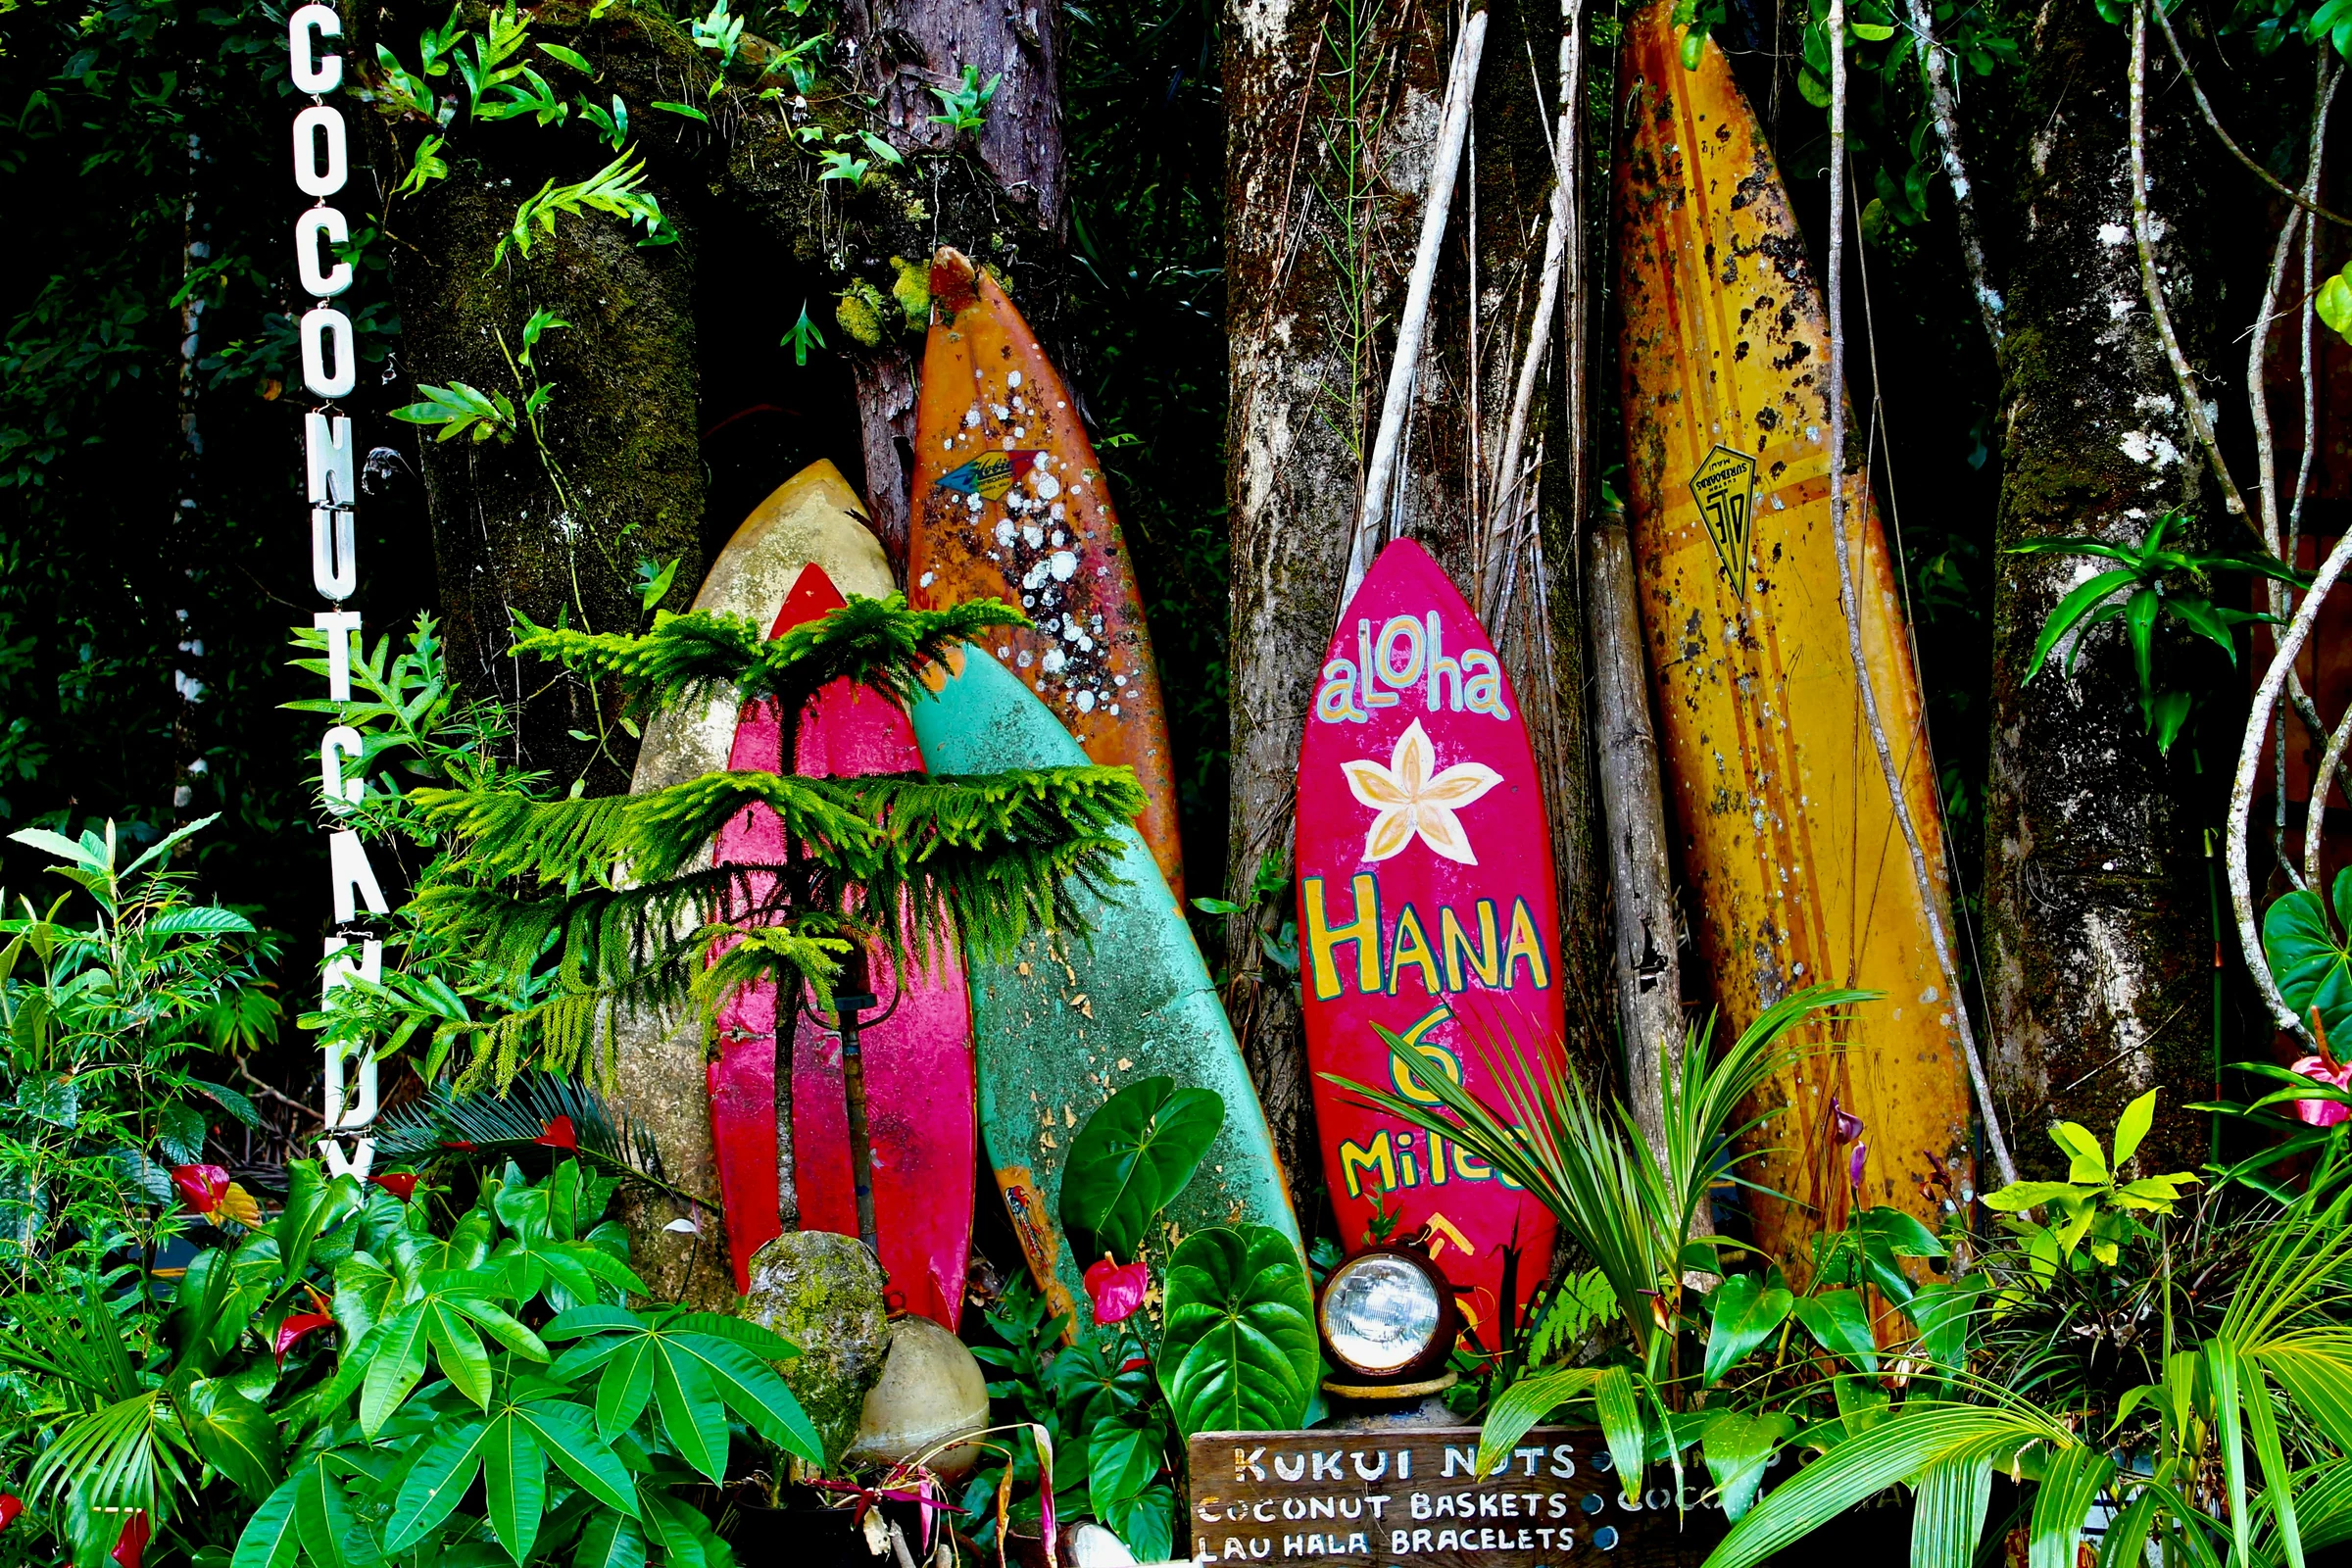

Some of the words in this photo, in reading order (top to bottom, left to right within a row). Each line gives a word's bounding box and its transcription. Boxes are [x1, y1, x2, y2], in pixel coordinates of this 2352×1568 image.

[1695, 463, 1747, 491] SURFBOARDS
[1708, 457, 1731, 471] MAUI
[1708, 478, 1737, 492] CUSTOM
[1302, 871, 1550, 1002] HANA
[1389, 1004, 1463, 1106] 6
[1233, 1446, 1412, 1483] KUKUI
[1197, 1494, 1392, 1523] COCONUT
[1410, 1492, 1567, 1520] BASKETS
[1198, 1536, 1271, 1563] LAU
[1284, 1532, 1368, 1557] HALA
[1392, 1527, 1574, 1555] BRACELETS
